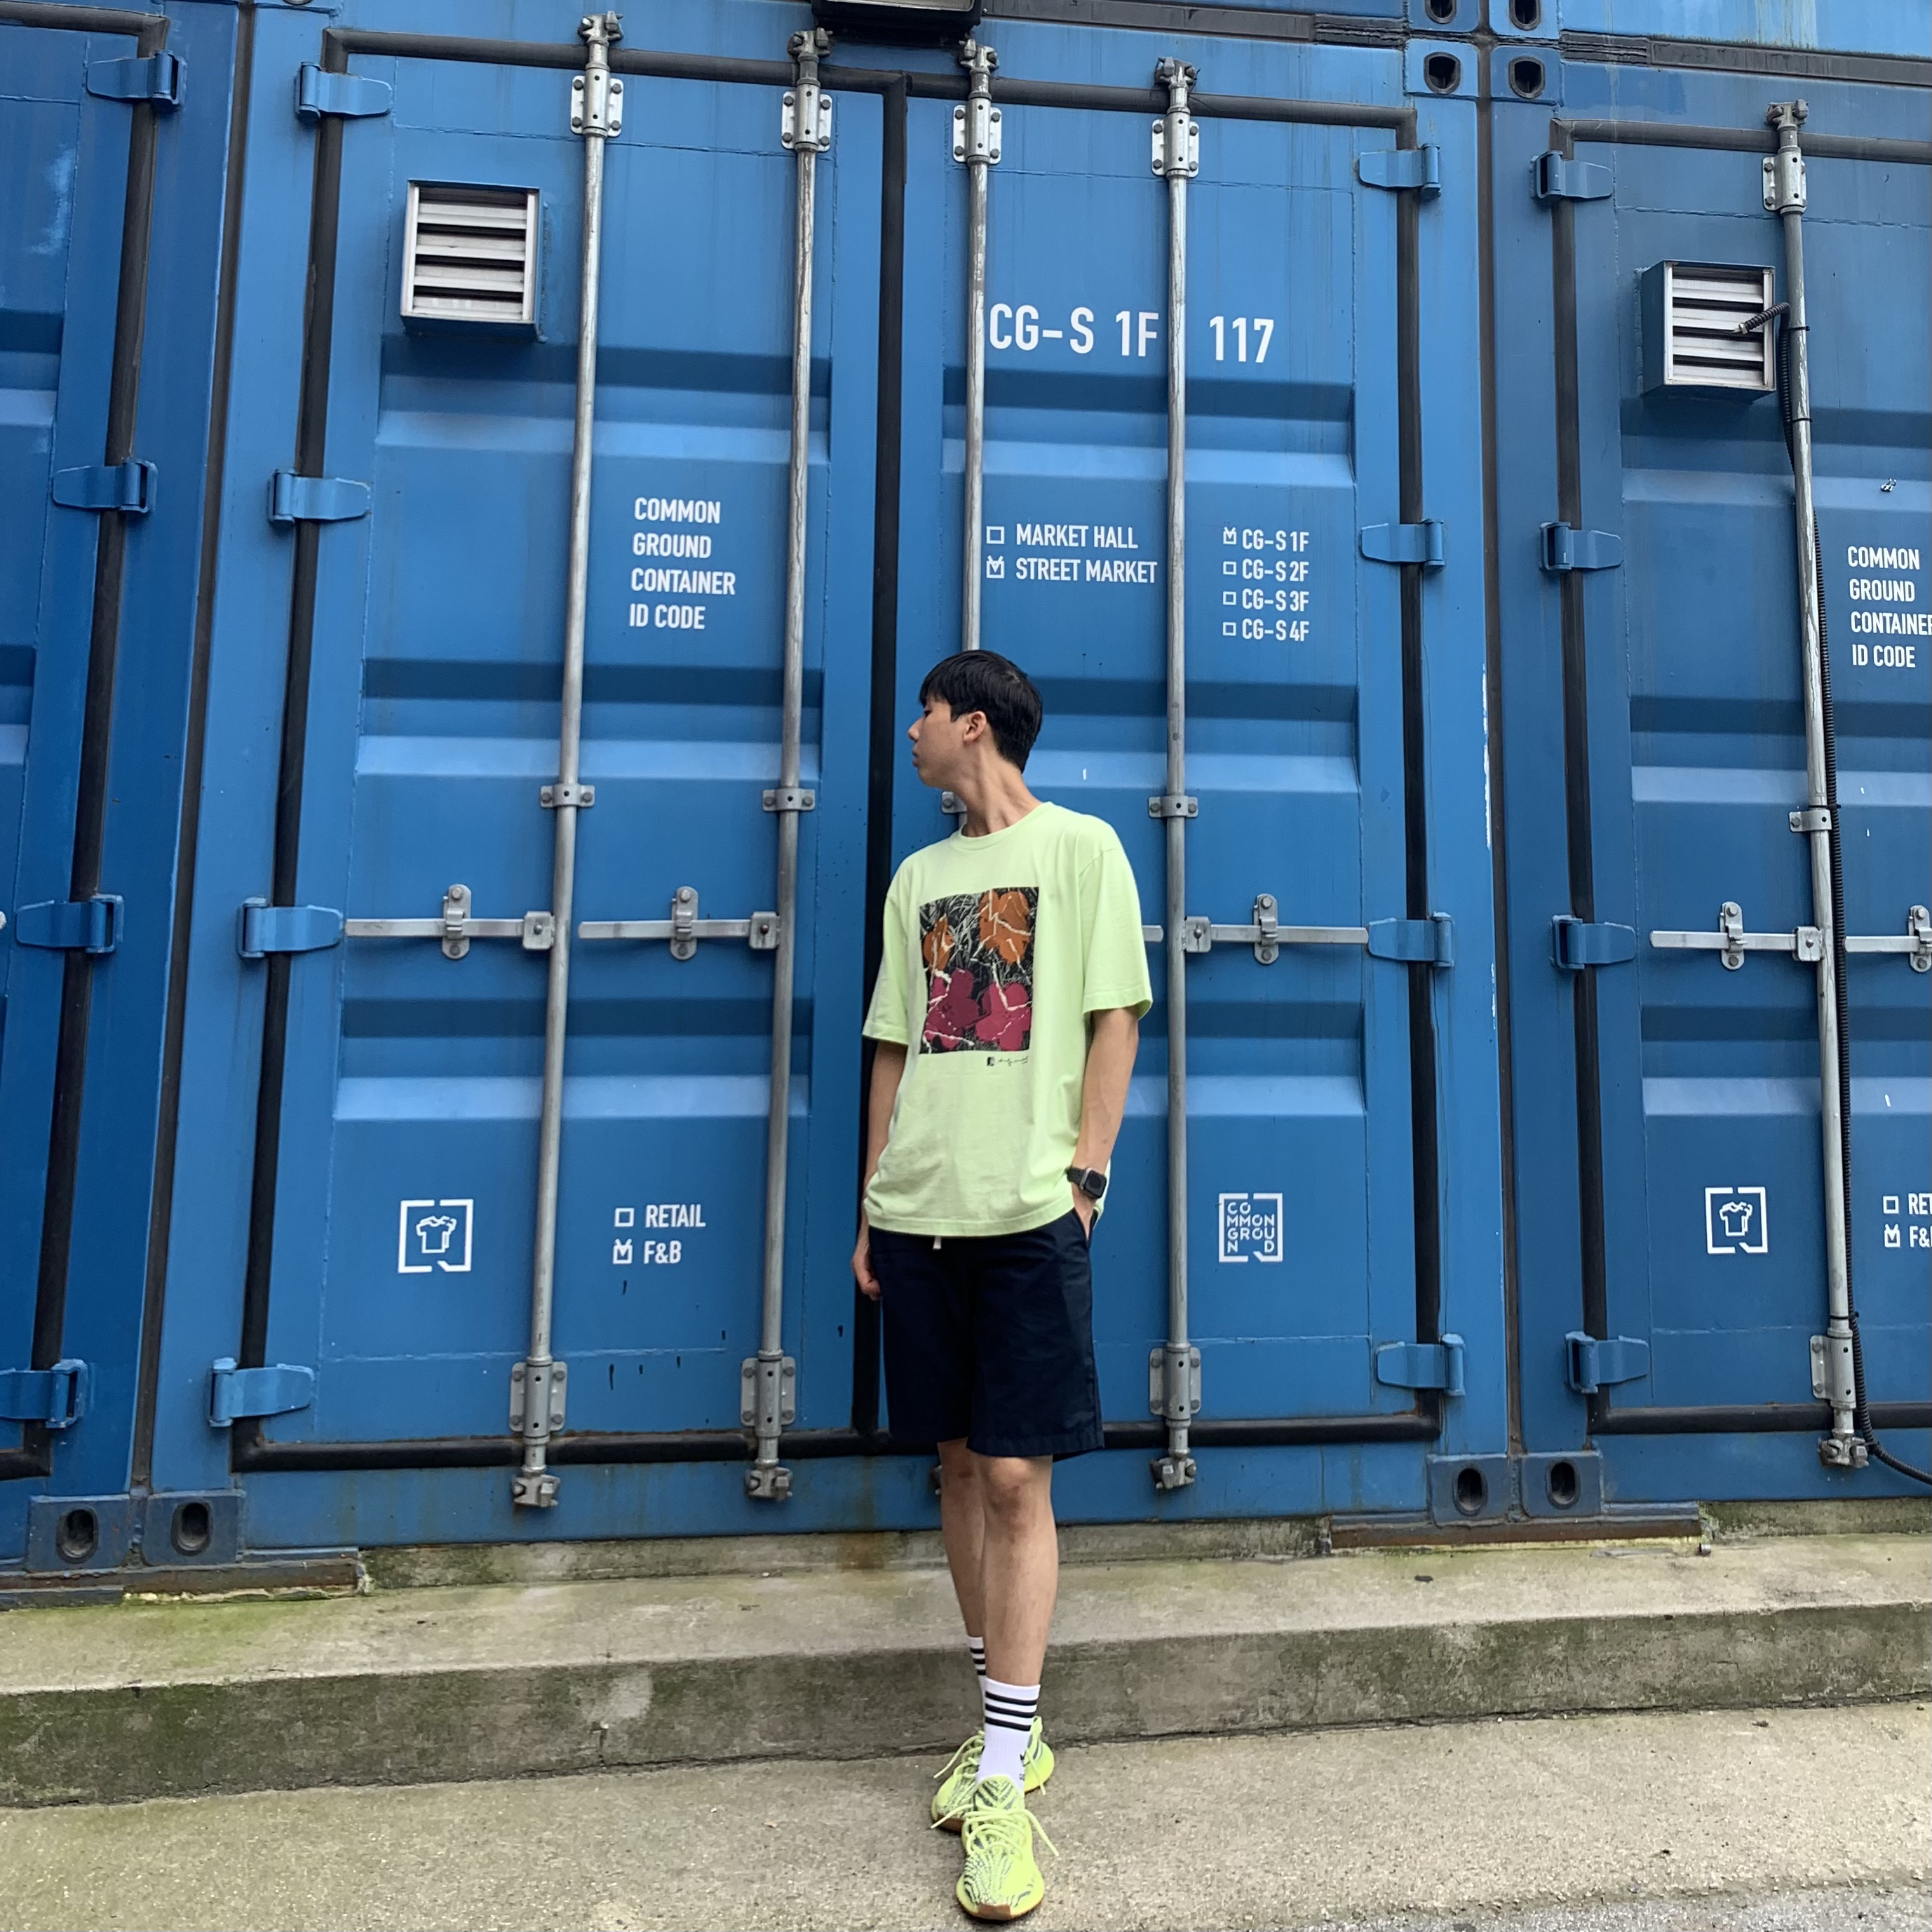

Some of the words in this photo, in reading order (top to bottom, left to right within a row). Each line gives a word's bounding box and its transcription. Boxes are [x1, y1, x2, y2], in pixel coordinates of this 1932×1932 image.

[1116, 311, 1159, 357] 1F
[1209, 316, 1274, 363] 117
[634, 496, 721, 525] COMMON
[633, 532, 712, 559] GROUND
[1016, 523, 1089, 548] MARKET
[1093, 525, 1139, 549] HALL
[1016, 558, 1081, 581] STREET
[1086, 560, 1158, 583] MARKET
[1847, 546, 1920, 570] COMMON
[630, 567, 736, 595] CONTAINER
[1849, 578, 1915, 602] GROUND
[629, 602, 649, 628] ID
[654, 604, 706, 630] CODE
[1852, 644, 1868, 666] ID
[1873, 644, 1916, 668] CODE
[644, 1203, 706, 1229] RETAIL
[1909, 1225, 1932, 1248] F&
[643, 1240, 682, 1264] F&B
